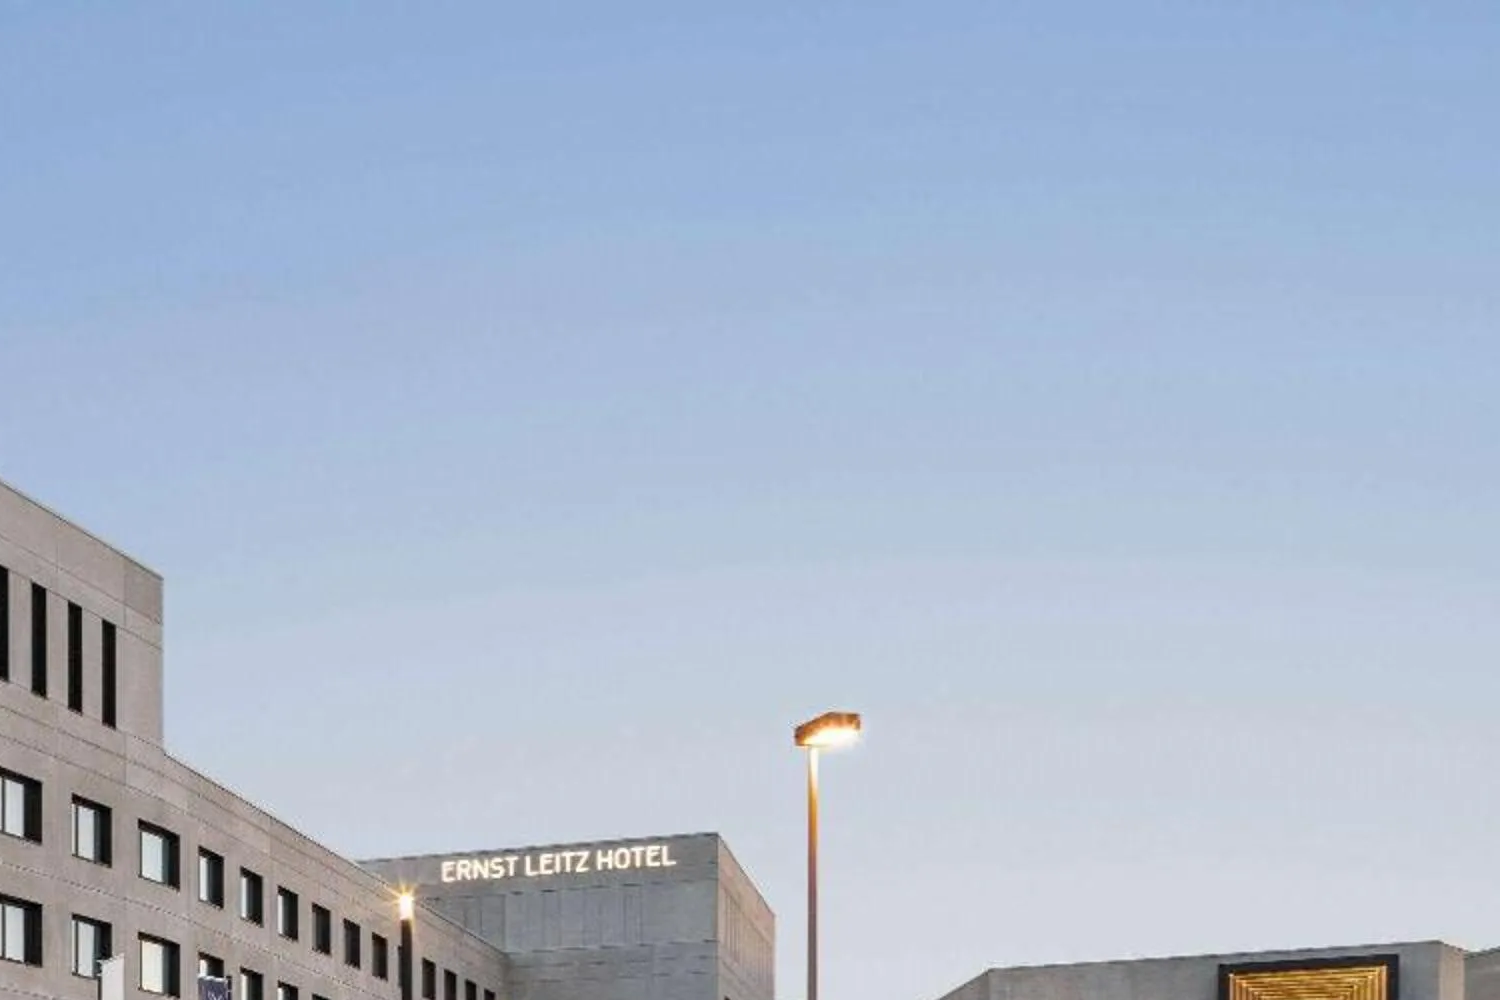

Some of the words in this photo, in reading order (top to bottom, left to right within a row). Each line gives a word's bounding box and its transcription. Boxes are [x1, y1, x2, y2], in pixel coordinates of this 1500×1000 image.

[441, 855, 519, 883] ERNST
[525, 850, 590, 877] LEITZ
[596, 845, 677, 871] HOTEL
